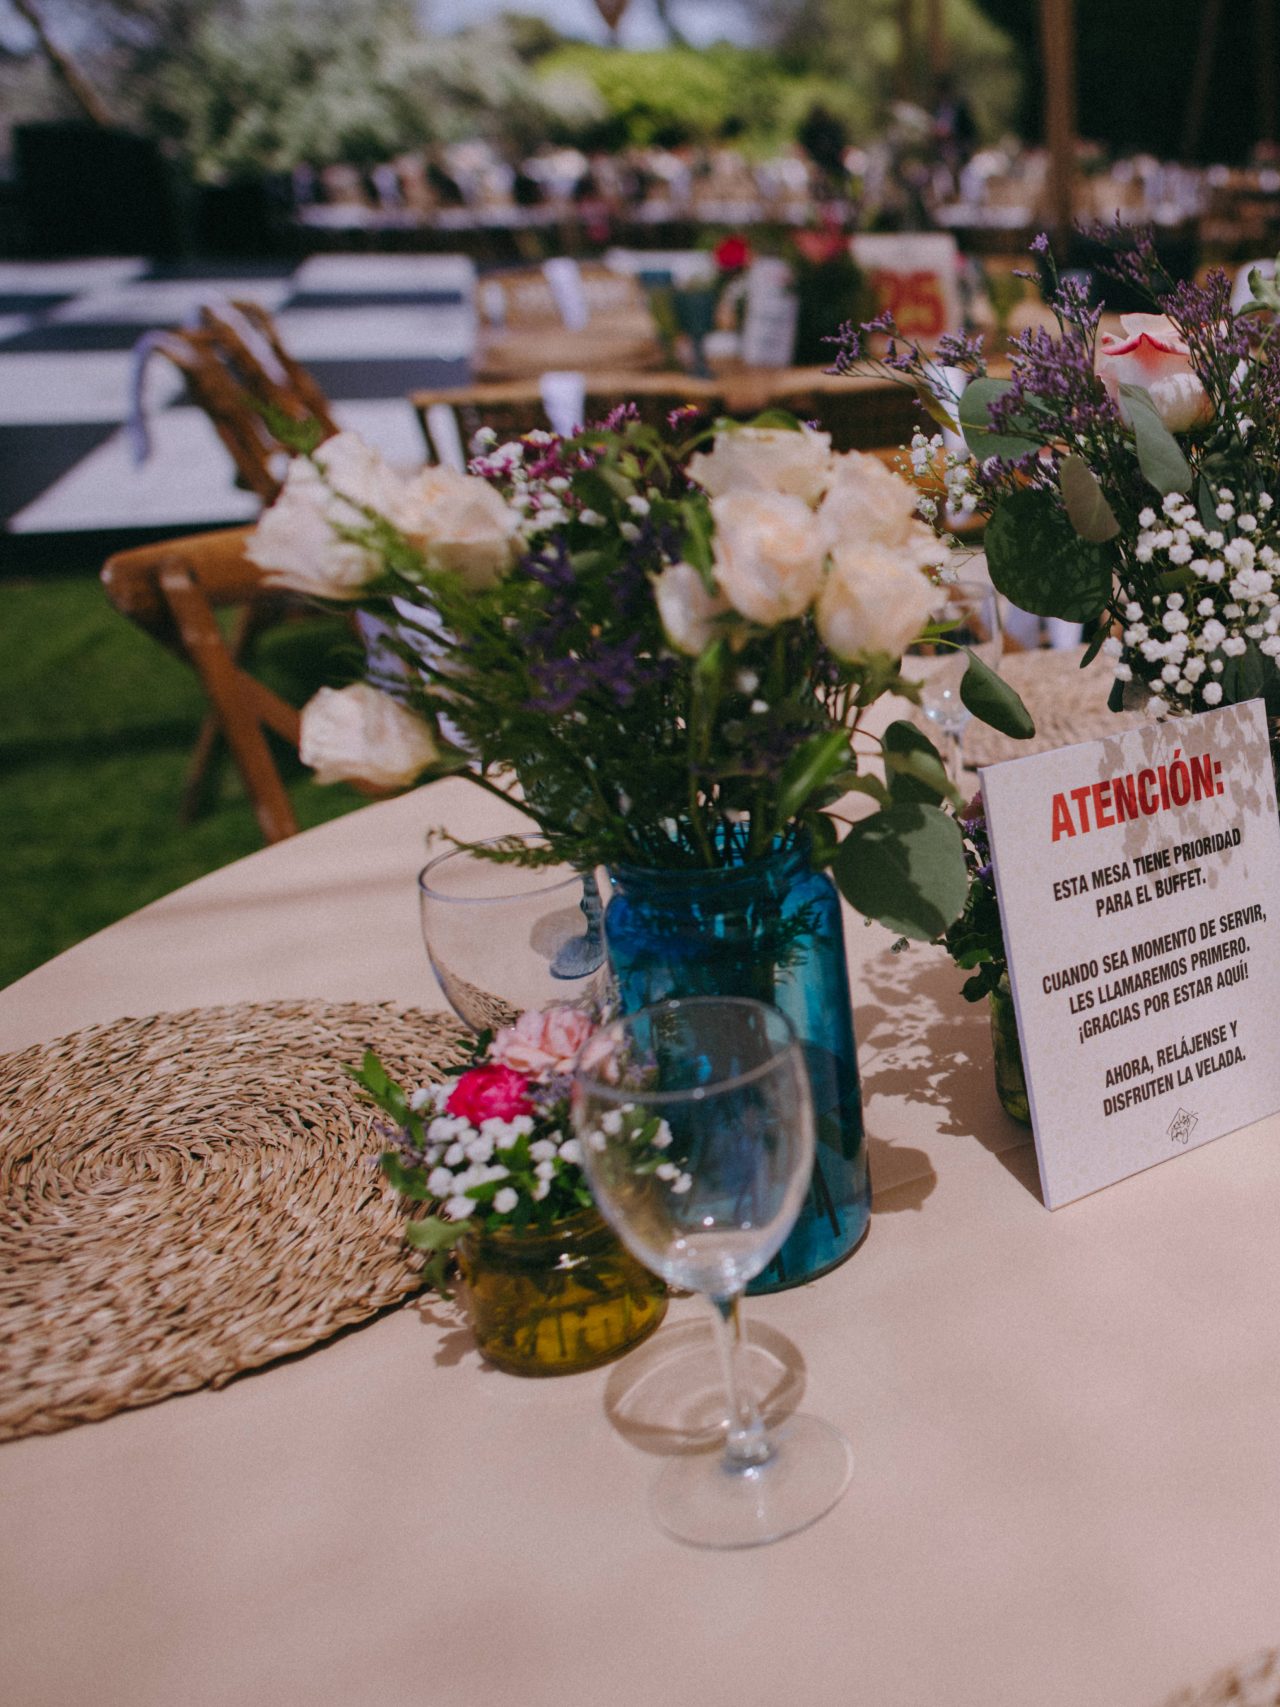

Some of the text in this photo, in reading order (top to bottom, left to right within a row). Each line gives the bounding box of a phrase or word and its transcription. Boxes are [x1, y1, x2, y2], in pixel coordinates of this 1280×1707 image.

[1051, 749, 1224, 842] ATENCIÓN:
[1053, 828, 1241, 901] ESTA MESA TIENE PRIORIDAD
[1096, 868, 1206, 917] PARA EL BUFFET.
[1043, 903, 1266, 995] CUANDO SEA MOMENTO DE SERVIR,
[1069, 936, 1250, 1014] LES LLAMAREMOS PRIMERO.
[1079, 962, 1249, 1044] ¡GRACIAS POR ESTAR AQUÍ!
[1103, 1046, 1246, 1117] DISFRUTEN LA VELADA.
[1105, 1020, 1238, 1088] AHORA, RELÁJENSE Y
